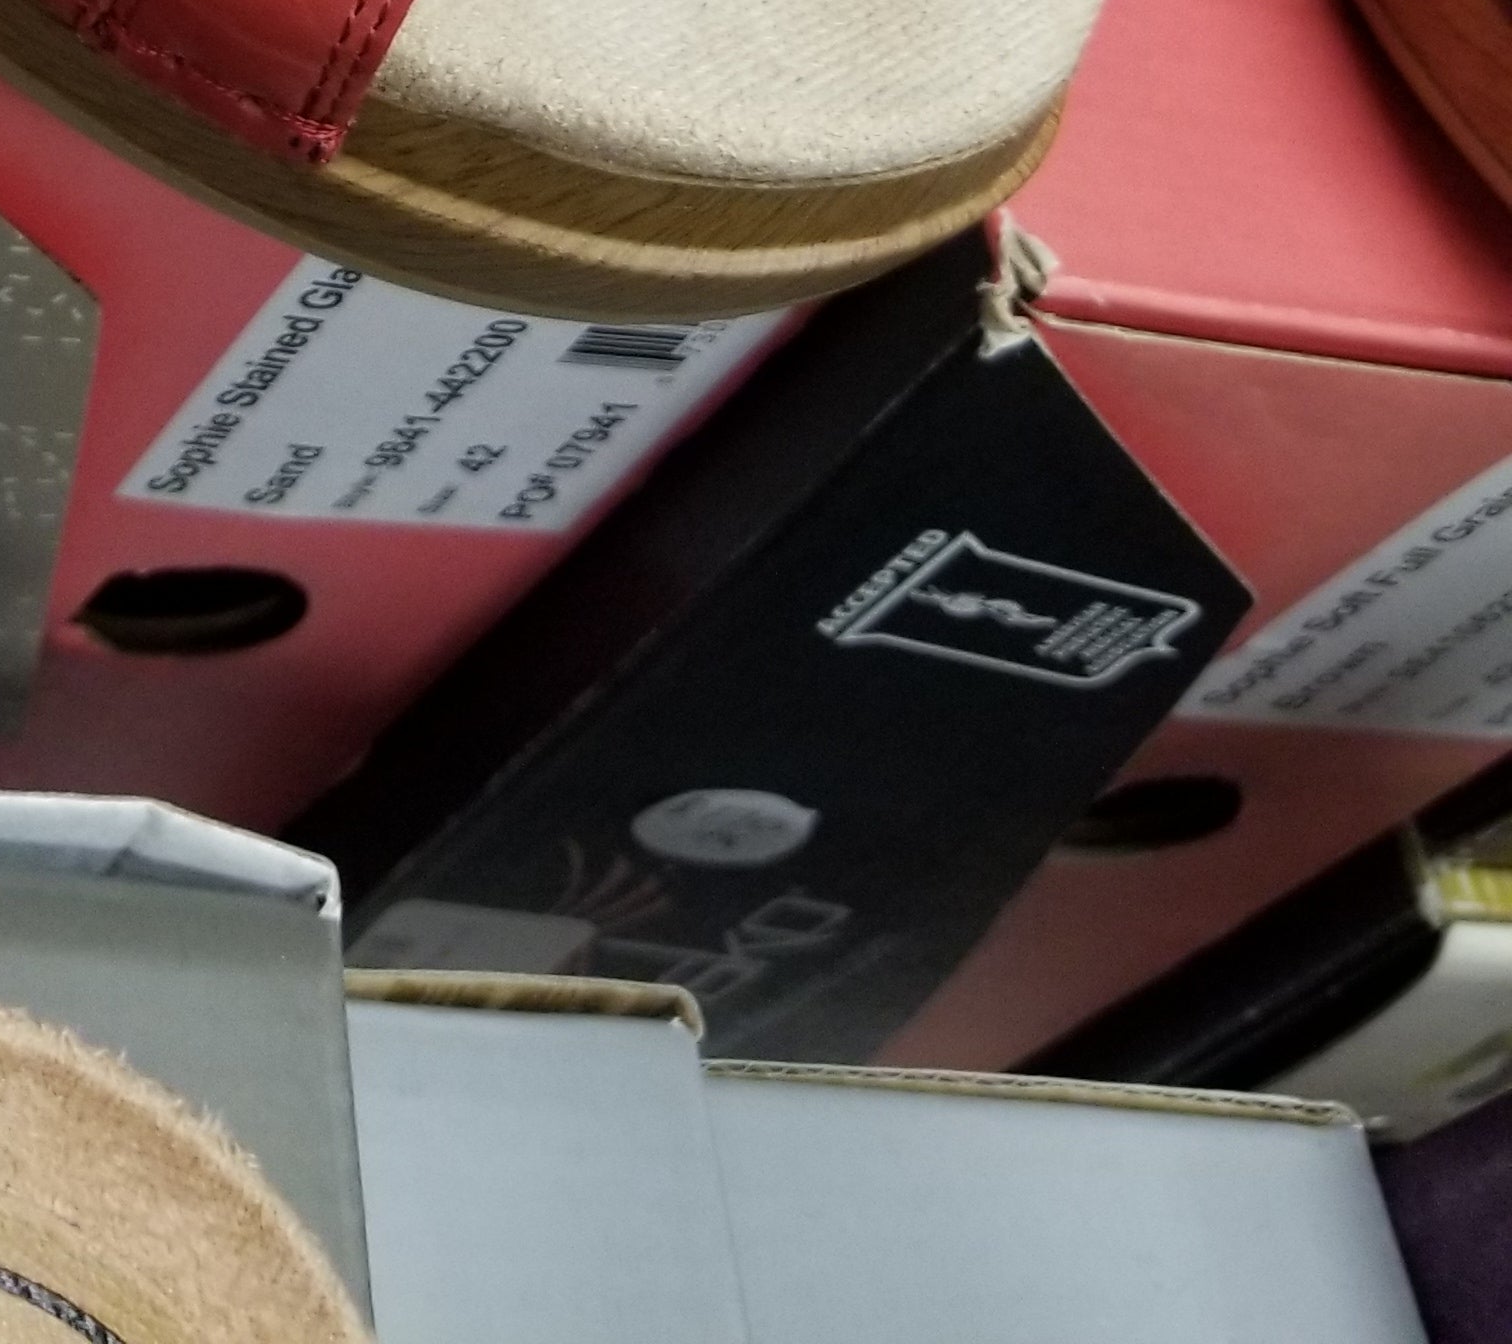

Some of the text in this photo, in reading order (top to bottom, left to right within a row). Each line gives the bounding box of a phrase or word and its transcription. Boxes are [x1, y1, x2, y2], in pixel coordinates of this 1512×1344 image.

[147, 268, 363, 494] Sophie Stained Gla
[364, 318, 528, 469] 9841-442200
[244, 443, 326, 504] Sand
[457, 443, 509, 474] 42
[499, 472, 557, 519] PO#
[546, 401, 639, 469] 07941
[815, 527, 951, 638] ACCEPTED
